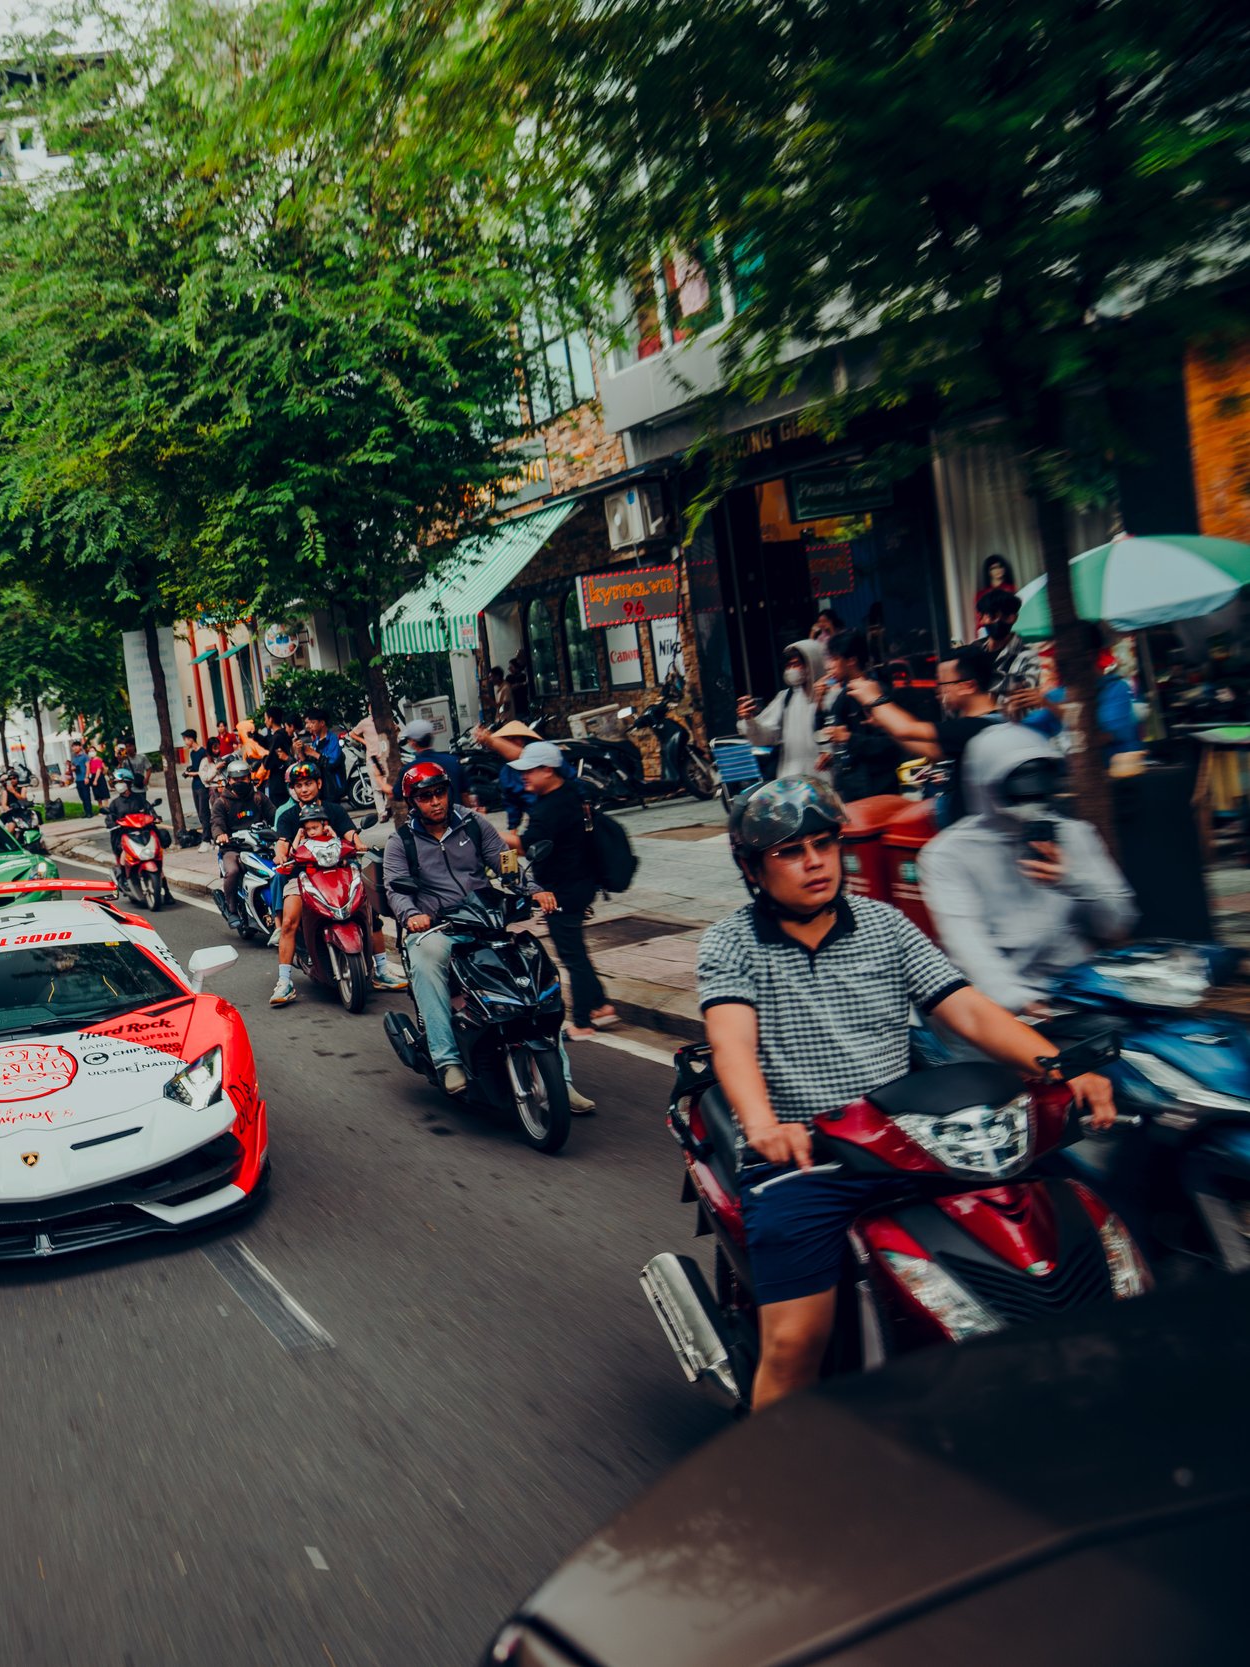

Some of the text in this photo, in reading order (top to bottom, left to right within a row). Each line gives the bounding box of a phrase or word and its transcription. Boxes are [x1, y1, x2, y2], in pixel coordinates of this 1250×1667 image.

[588, 578, 673, 606] kyma.vn
[622, 600, 645, 617] 96
[610, 649, 640, 664] Canon
[14, 931, 72, 945] 3000
[78, 1024, 123, 1040] Hard
[80, 1041, 112, 1051] BANG
[126, 1031, 179, 1043] OLUFSEN
[112, 1042, 181, 1056] CHIP MONG
[145, 1047, 183, 1056] GROUP
[87, 1059, 188, 1076] ULYSSE NARDIN
